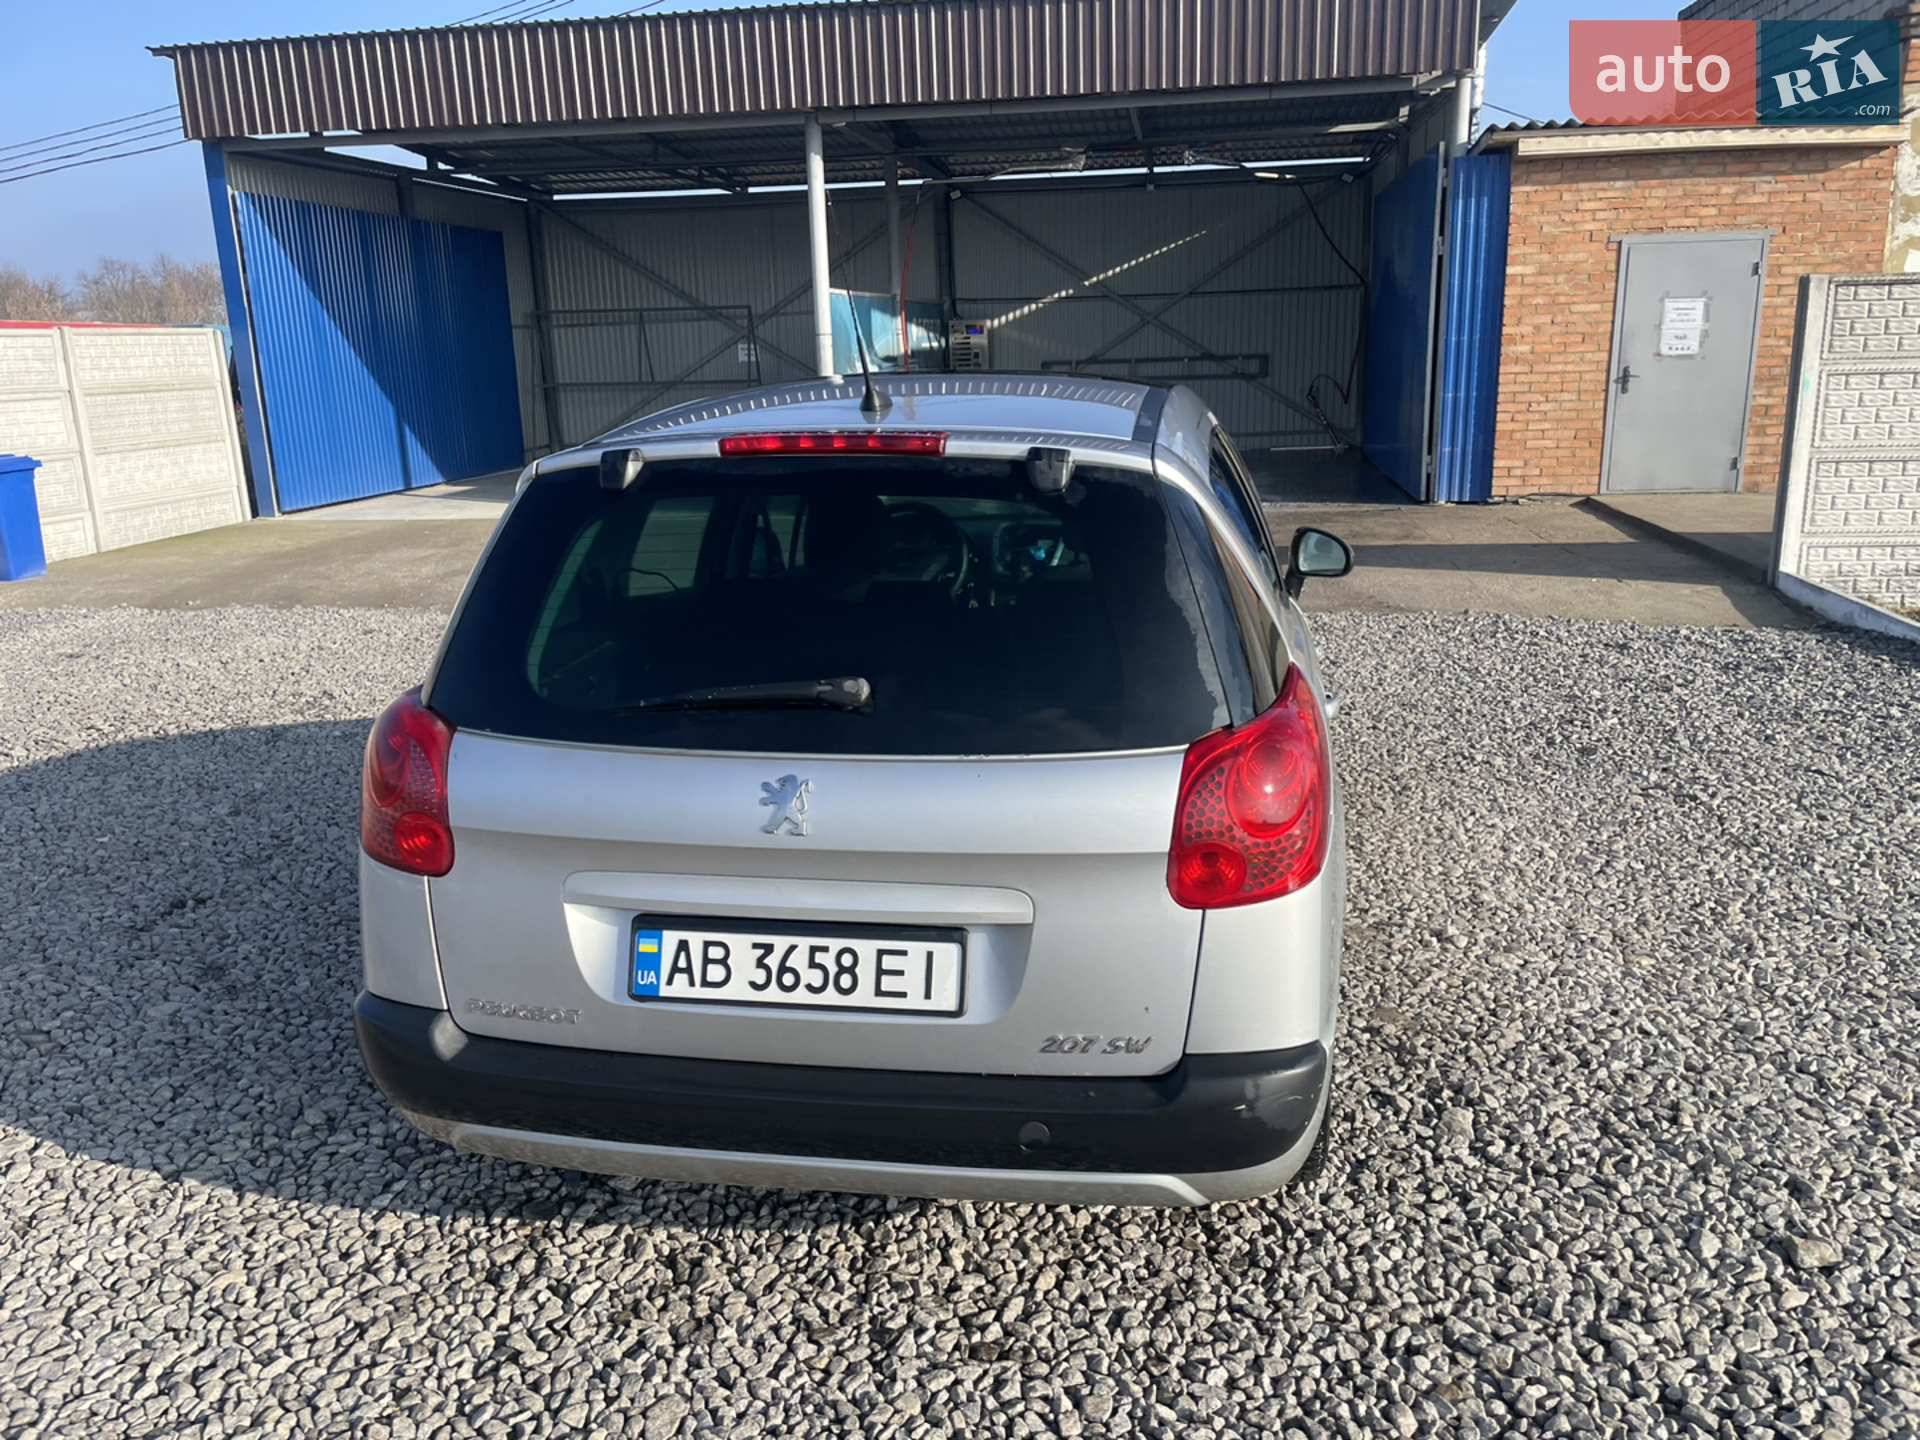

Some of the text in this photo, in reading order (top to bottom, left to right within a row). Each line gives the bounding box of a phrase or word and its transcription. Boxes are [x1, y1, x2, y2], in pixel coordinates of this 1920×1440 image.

[637, 970, 658, 986] UA
[665, 939, 934, 1000] AB 3658 EI
[466, 998, 582, 1024] PEUGEOT
[1038, 1034, 1154, 1054] 207 SW
